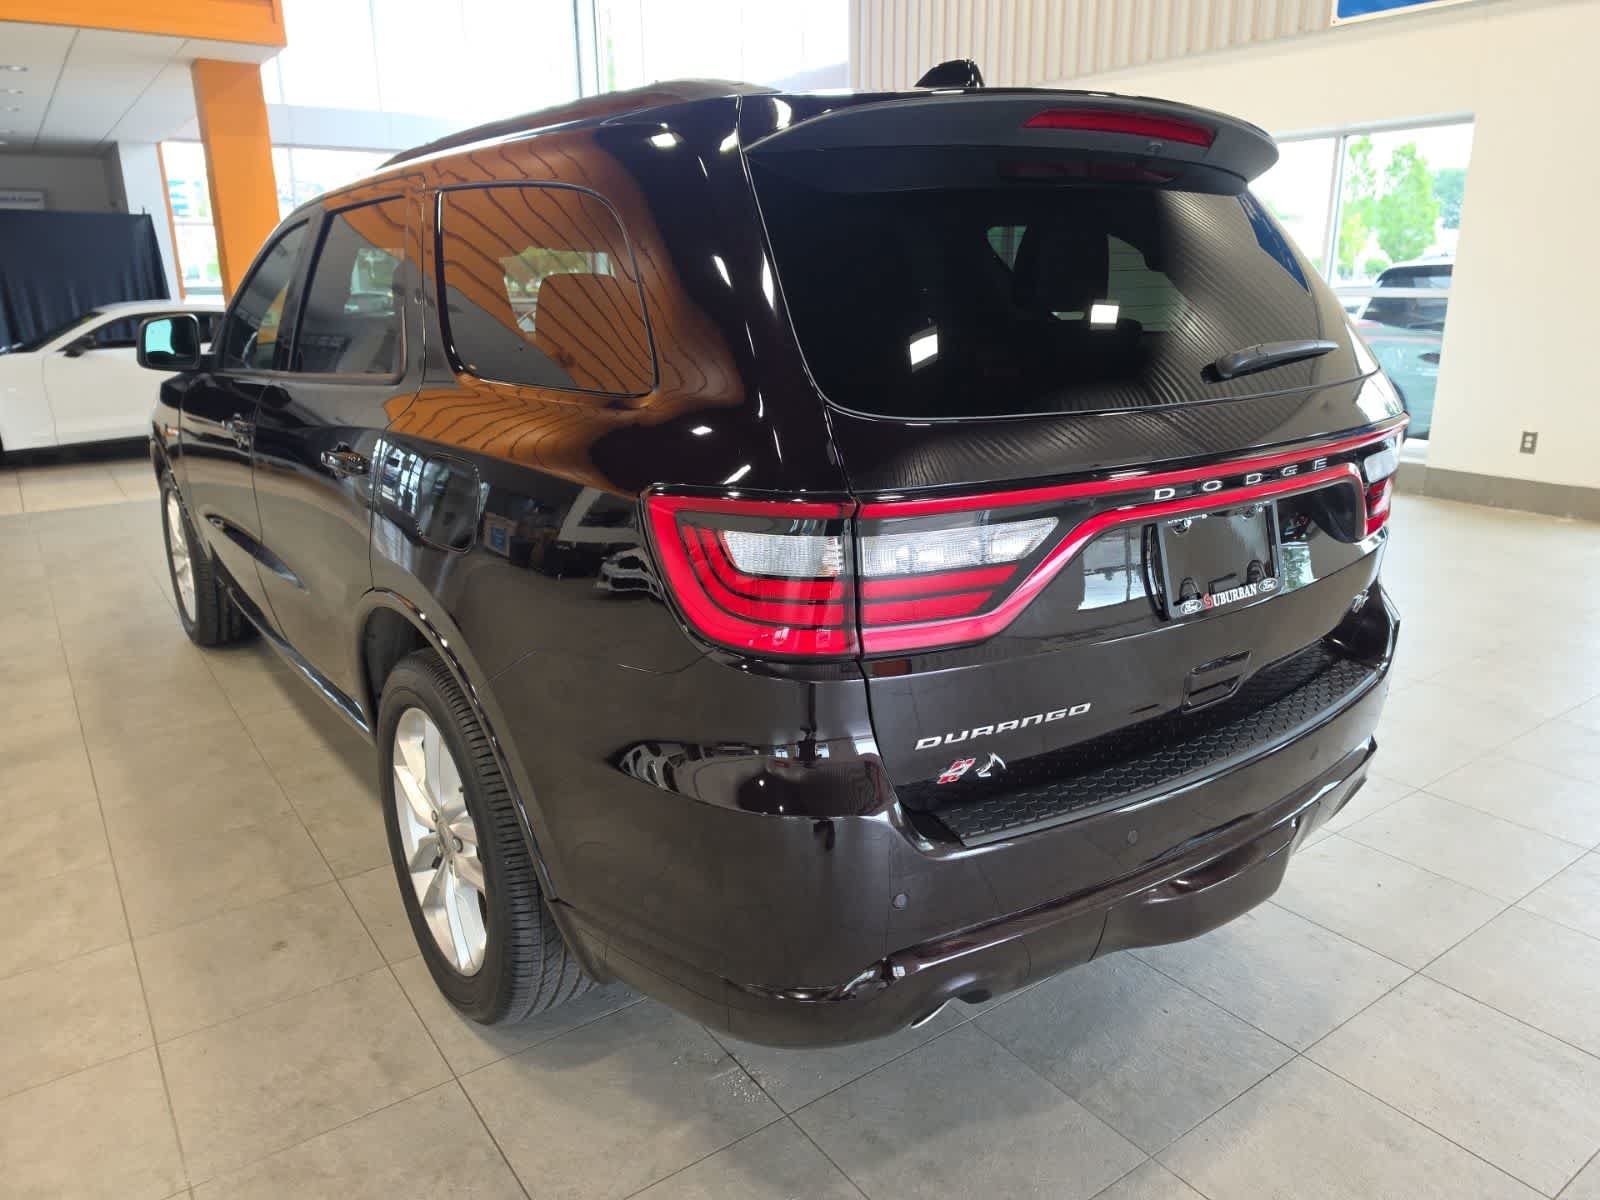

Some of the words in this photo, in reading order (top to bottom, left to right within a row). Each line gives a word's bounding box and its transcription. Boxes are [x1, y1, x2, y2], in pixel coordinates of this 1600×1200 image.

[1153, 457, 1328, 501] DODGE
[1183, 600, 1201, 614] Ford
[1203, 583, 1257, 610] SUBURBAN
[1260, 579, 1277, 592] Ford
[914, 702, 1092, 751] DURANGO
